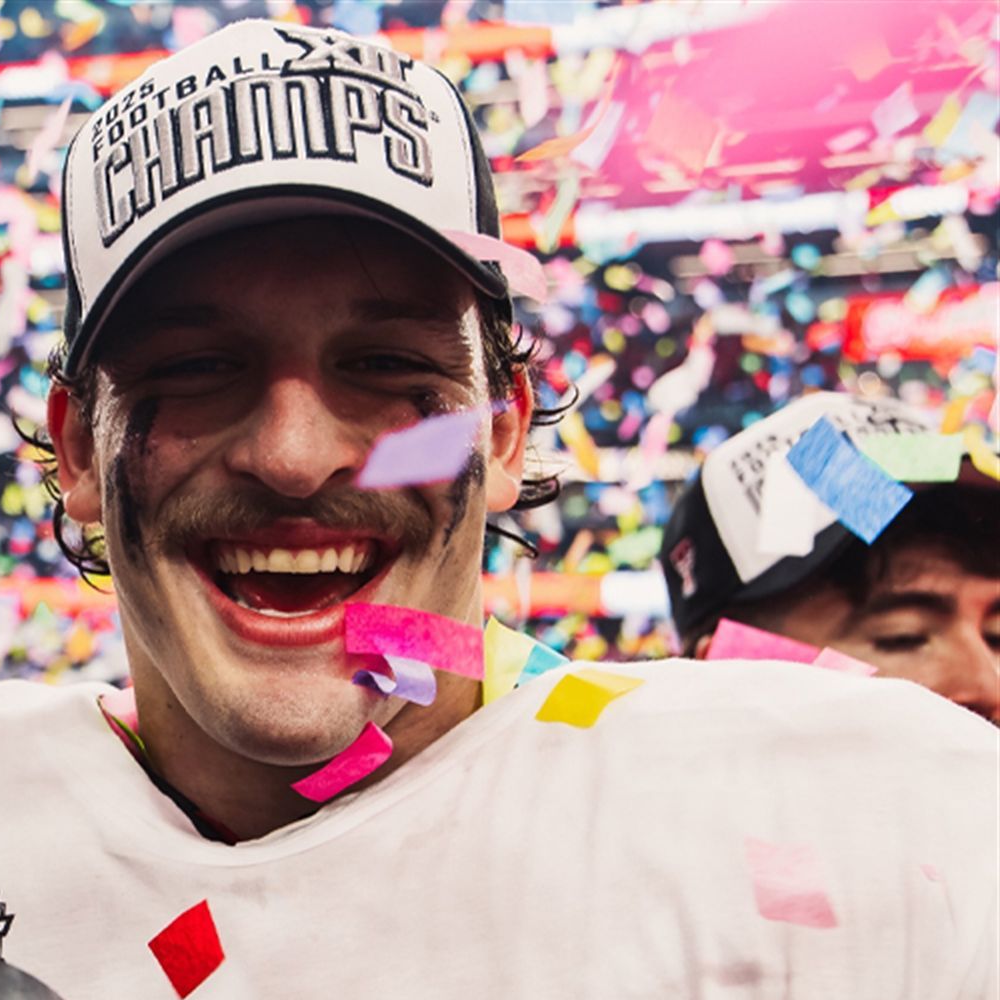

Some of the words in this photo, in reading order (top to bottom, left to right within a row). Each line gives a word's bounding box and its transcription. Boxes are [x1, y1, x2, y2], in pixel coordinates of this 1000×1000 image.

[274, 26, 414, 86] XII
[92, 78, 155, 142] 2025
[93, 52, 281, 162] FOOTBALL
[93, 72, 434, 248] CHAMPS
